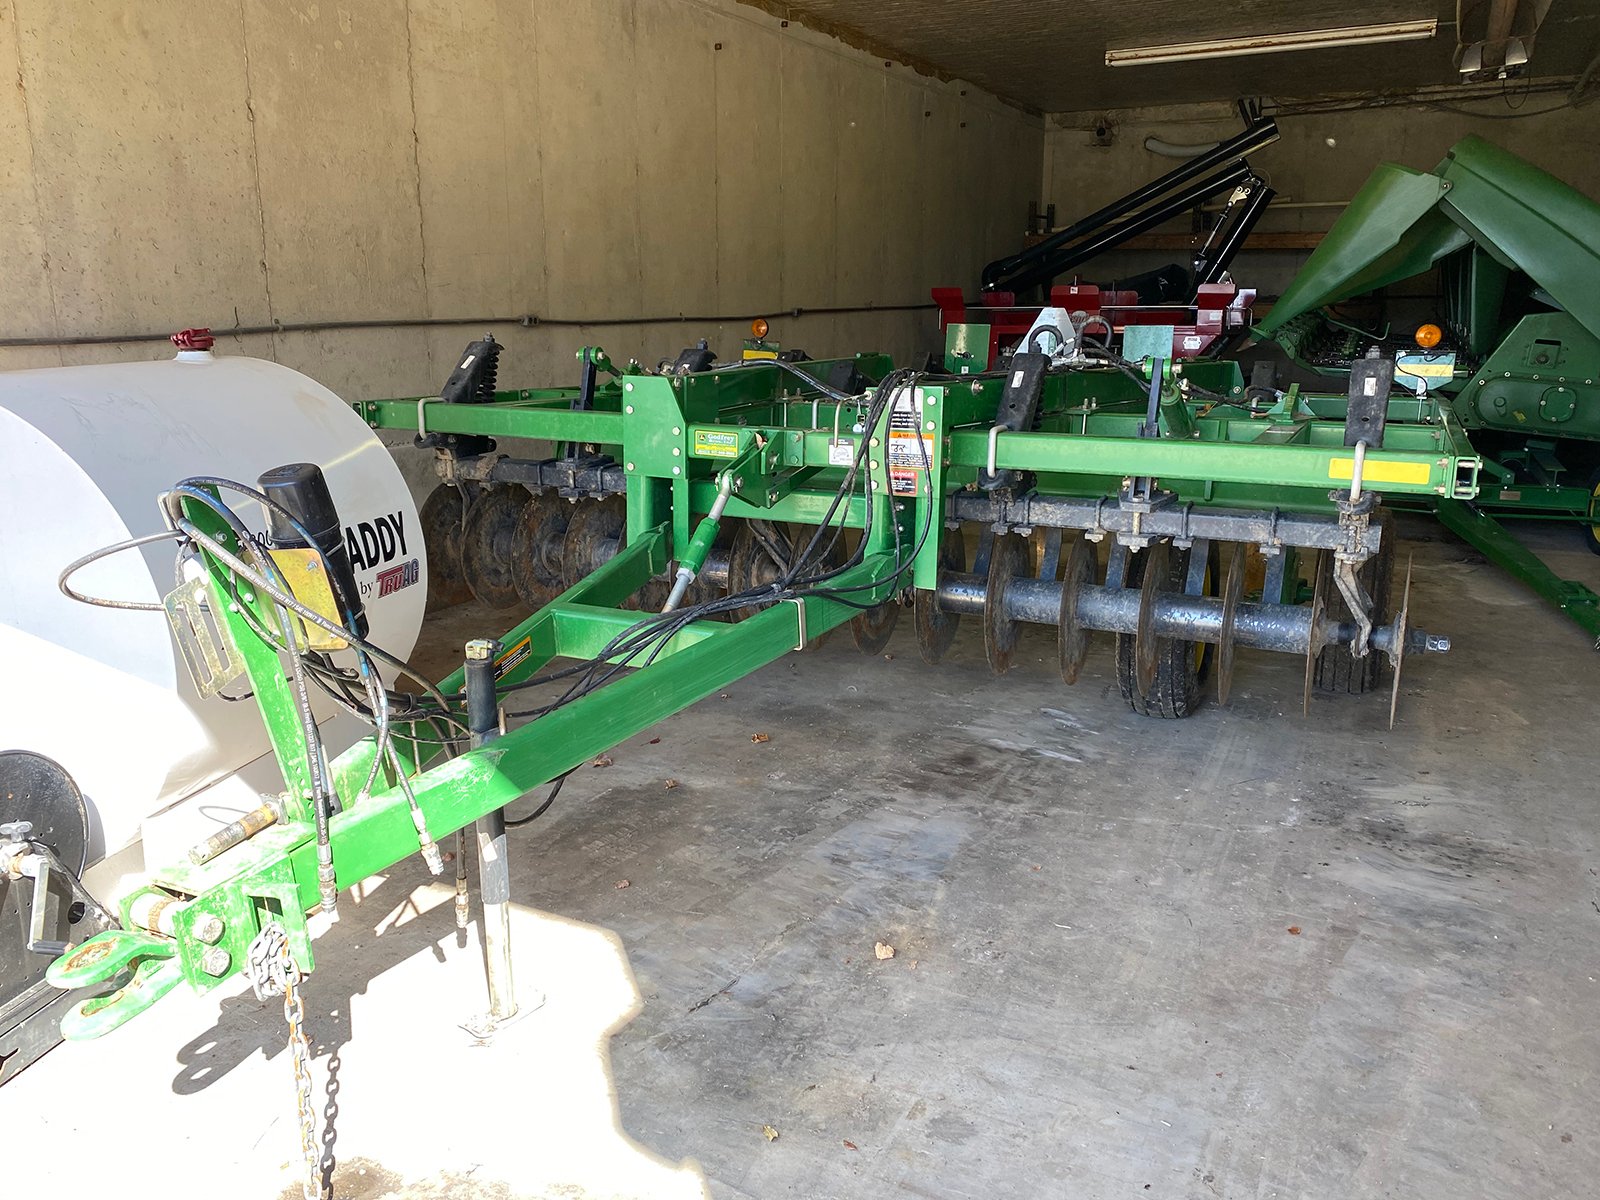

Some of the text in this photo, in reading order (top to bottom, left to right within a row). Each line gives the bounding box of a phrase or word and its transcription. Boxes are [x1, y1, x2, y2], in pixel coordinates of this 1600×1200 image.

[708, 434, 734, 444] Godfrey
[346, 511, 408, 574] ADDY
[360, 582, 374, 598] by
